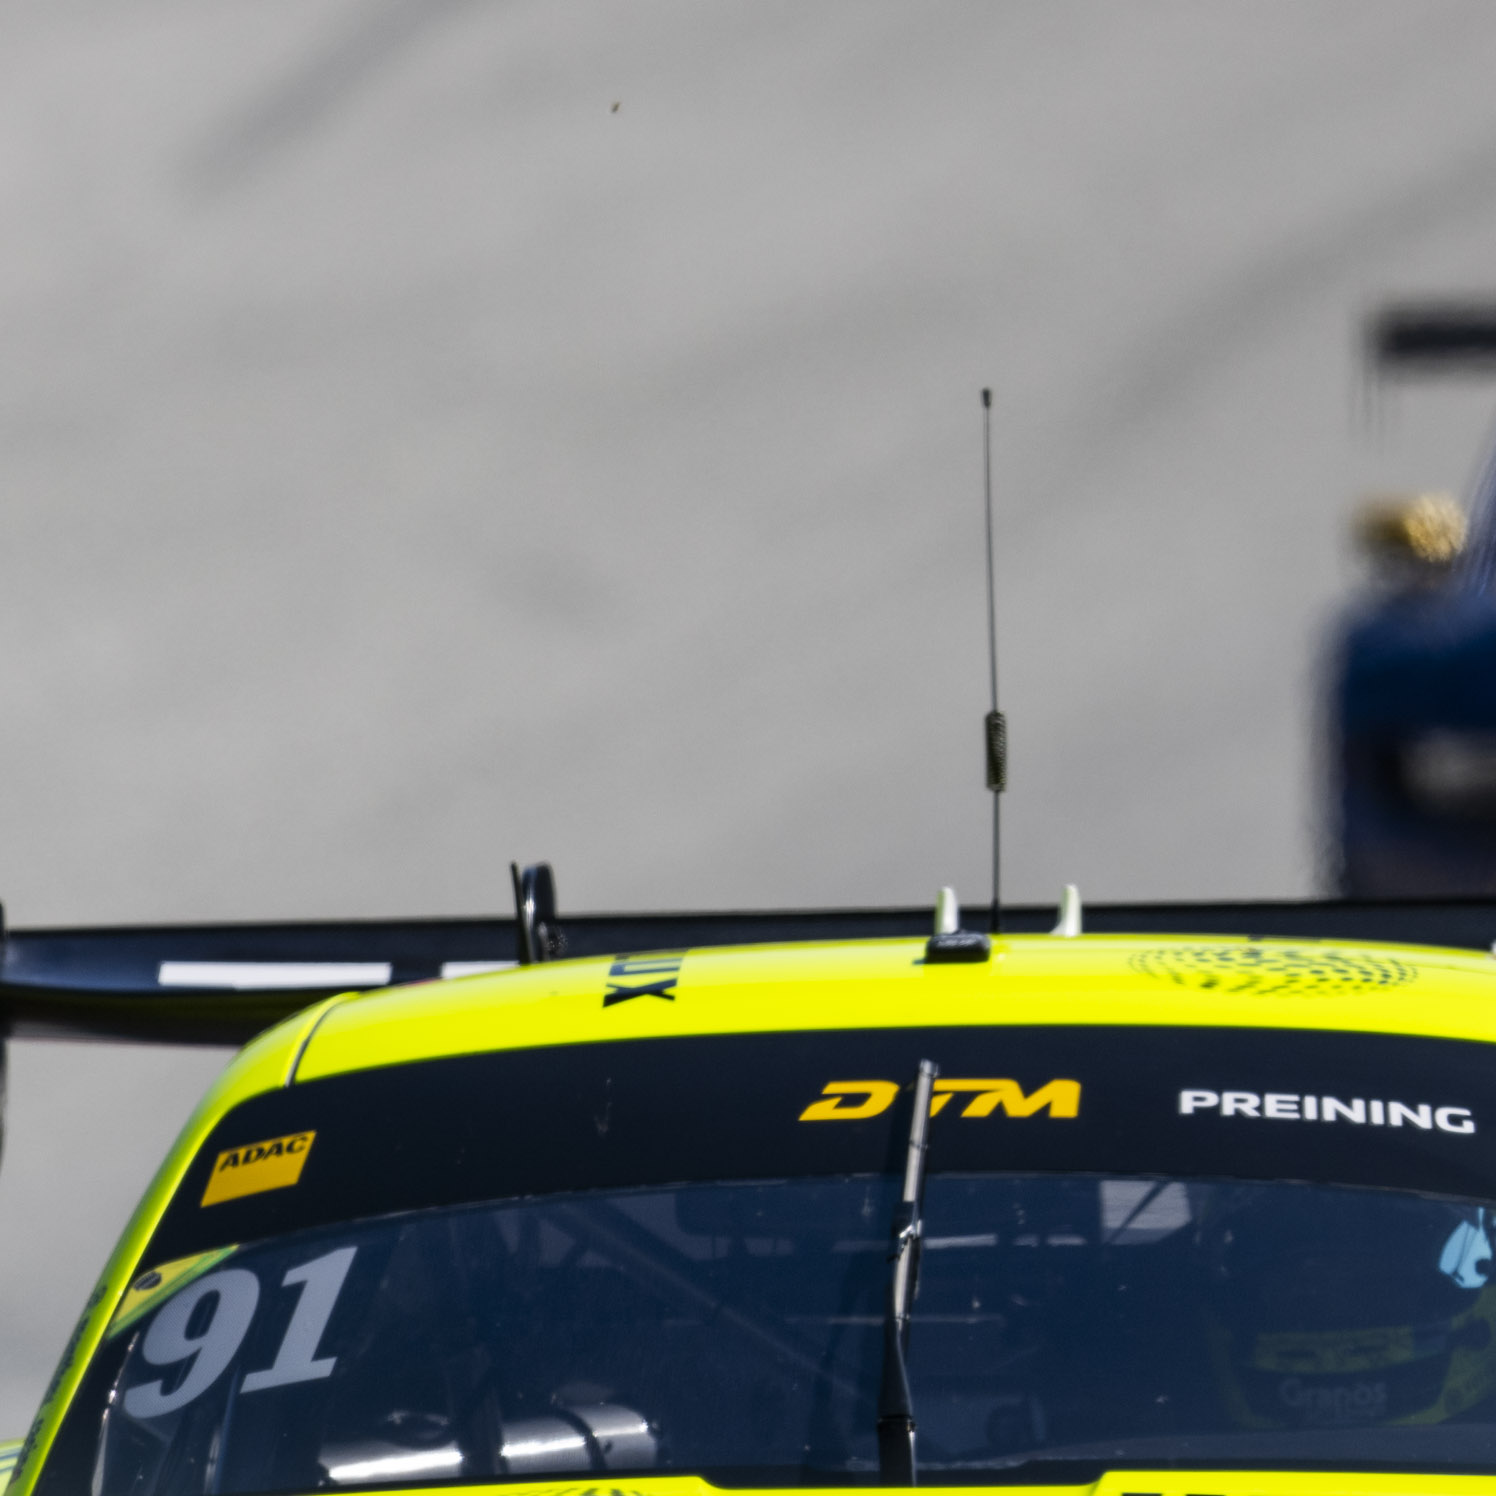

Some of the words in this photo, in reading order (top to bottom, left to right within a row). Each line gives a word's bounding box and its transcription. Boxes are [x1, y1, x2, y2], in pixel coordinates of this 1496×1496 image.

[798, 1078, 1081, 1121] DTM
[1178, 1089, 1476, 1134] PREINING
[218, 1135, 309, 1173] ADAC
[123, 1246, 359, 1419] 91
